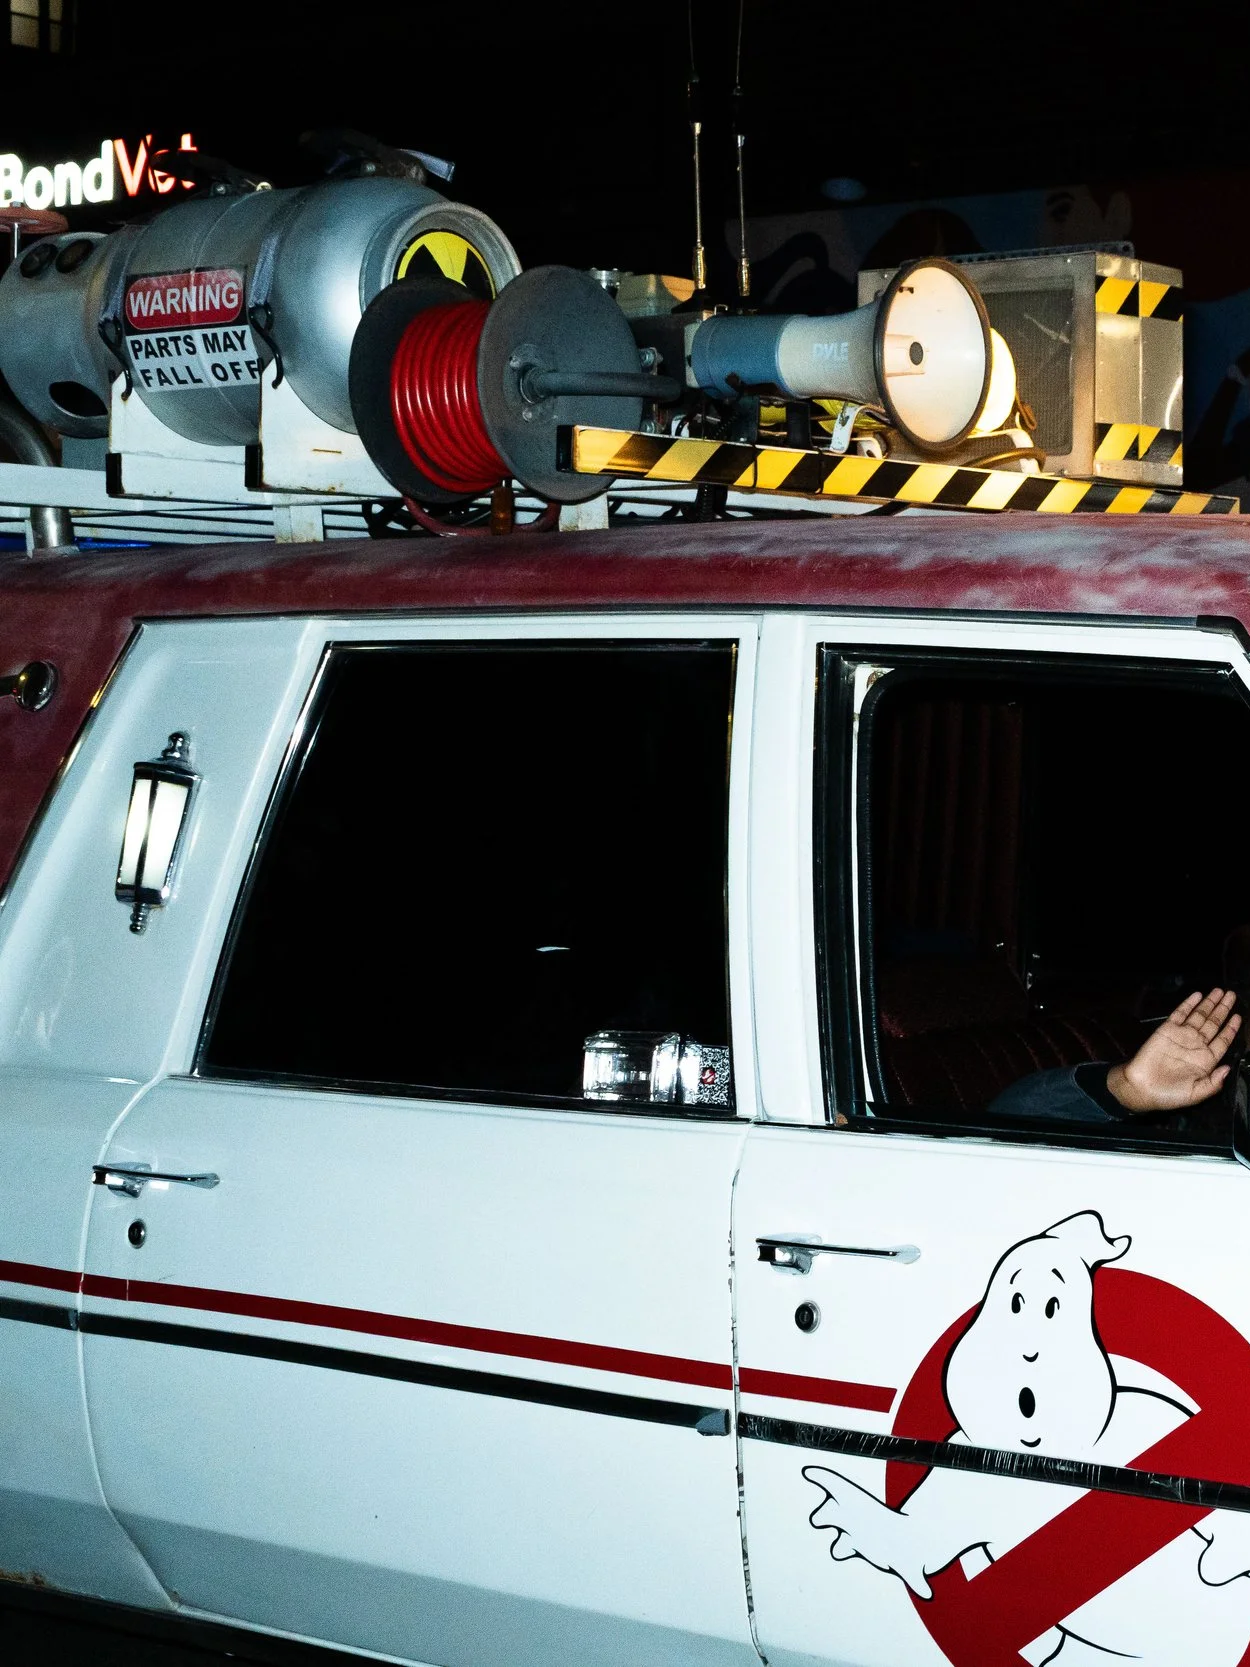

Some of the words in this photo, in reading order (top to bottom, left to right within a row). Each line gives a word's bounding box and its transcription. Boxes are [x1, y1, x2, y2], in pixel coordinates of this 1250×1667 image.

[130, 282, 239, 318] WARNING
[129, 334, 196, 361] PARTS
[202, 329, 247, 355] MAY
[812, 341, 849, 361] PYLE
[139, 365, 203, 389] FALL
[210, 360, 263, 383] OFF
